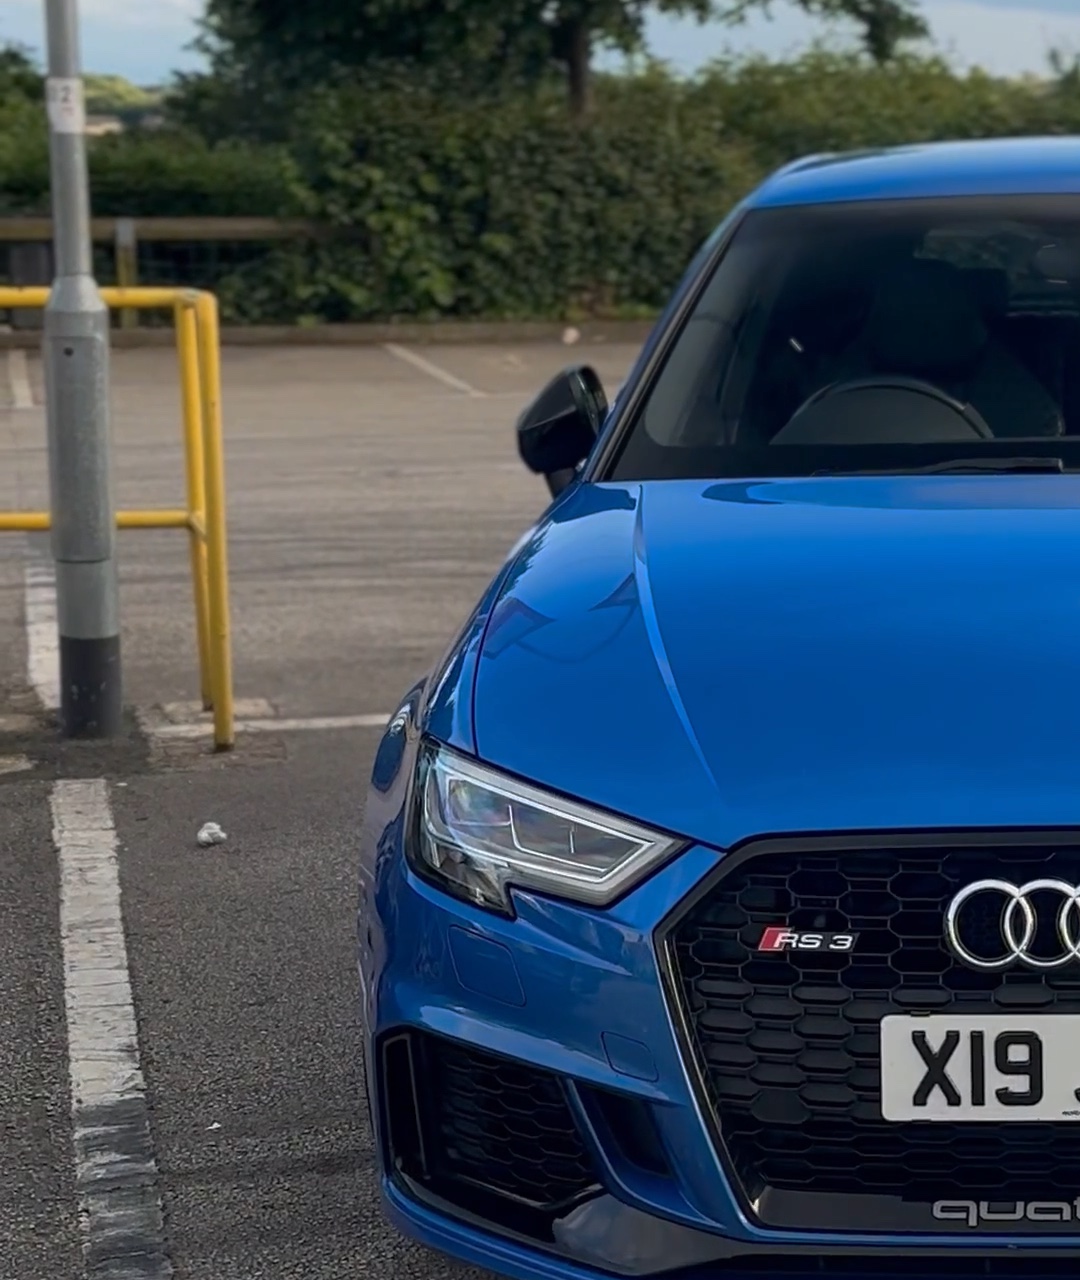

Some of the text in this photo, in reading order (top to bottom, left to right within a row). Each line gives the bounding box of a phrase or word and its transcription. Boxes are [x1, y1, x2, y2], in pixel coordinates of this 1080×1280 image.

[773, 932, 853, 950] RS 3
[911, 1030, 1044, 1107] X19
